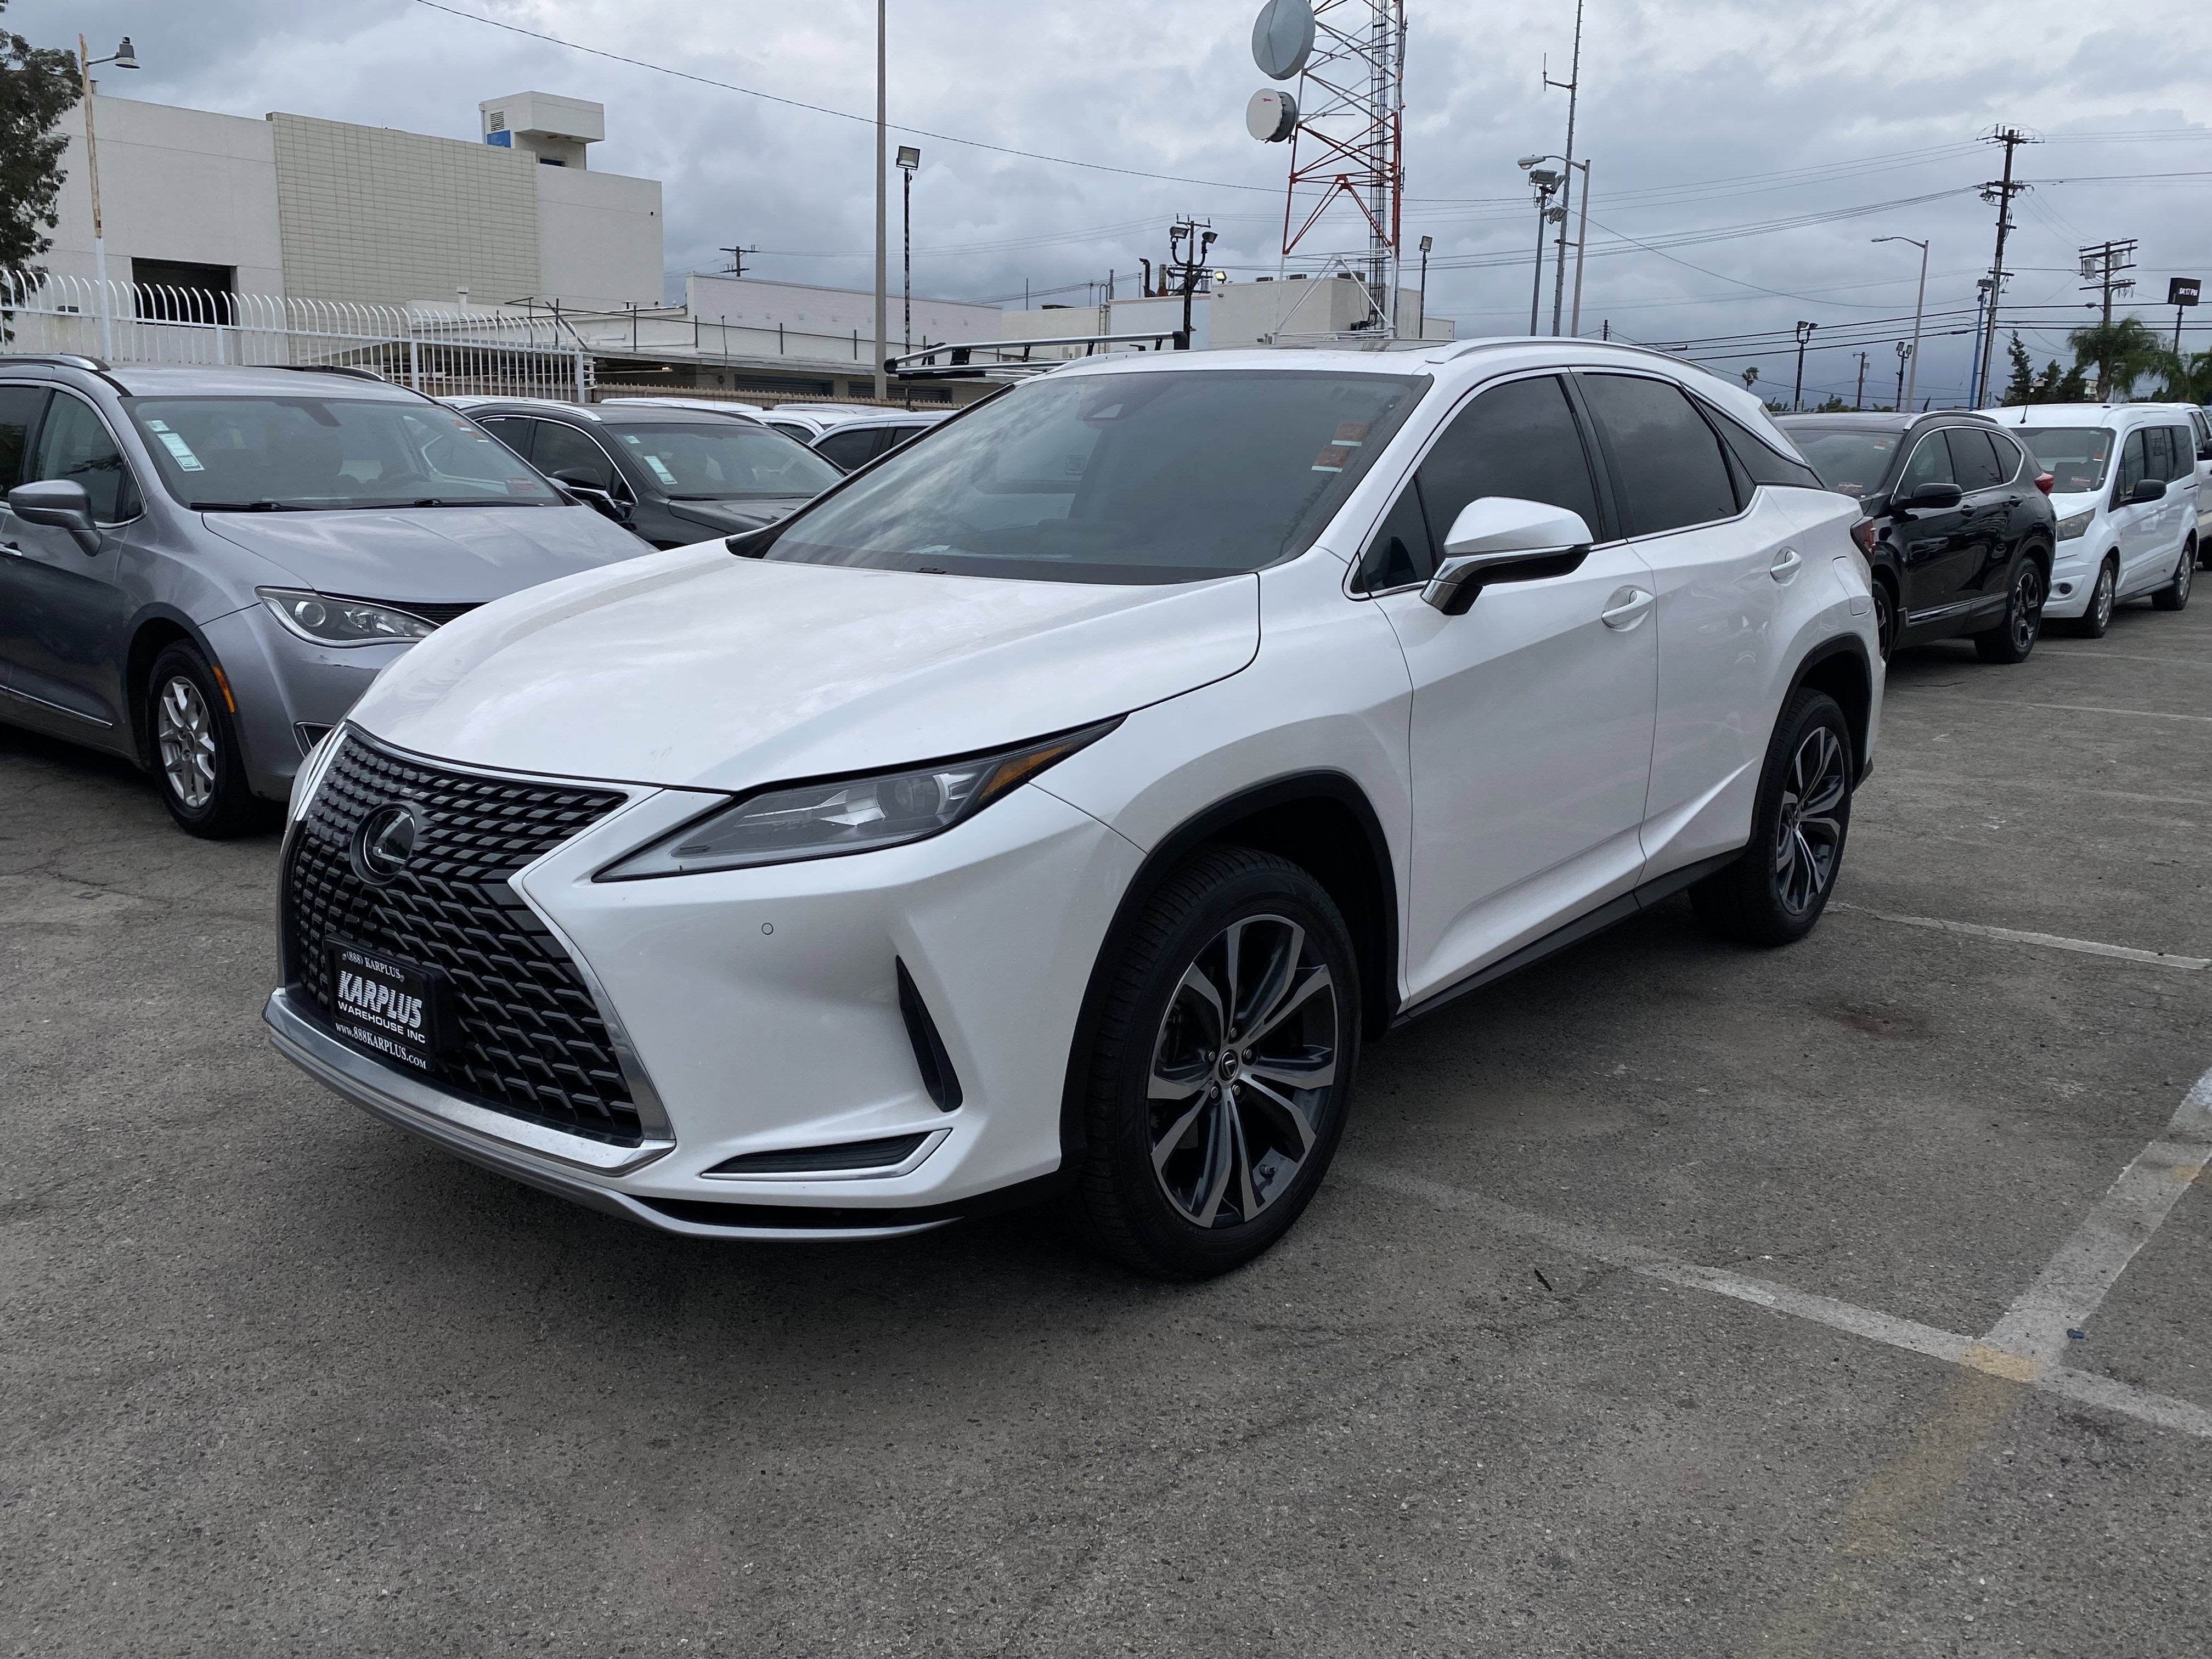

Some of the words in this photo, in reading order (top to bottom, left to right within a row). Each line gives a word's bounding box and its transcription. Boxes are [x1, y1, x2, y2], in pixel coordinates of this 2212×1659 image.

[346, 951, 363, 965] (888)
[364, 957, 400, 979] KARPLUS
[337, 970, 422, 1028] KARPLUS
[337, 1000, 404, 1035] WAREHOUSE
[407, 1029, 425, 1044] INC
